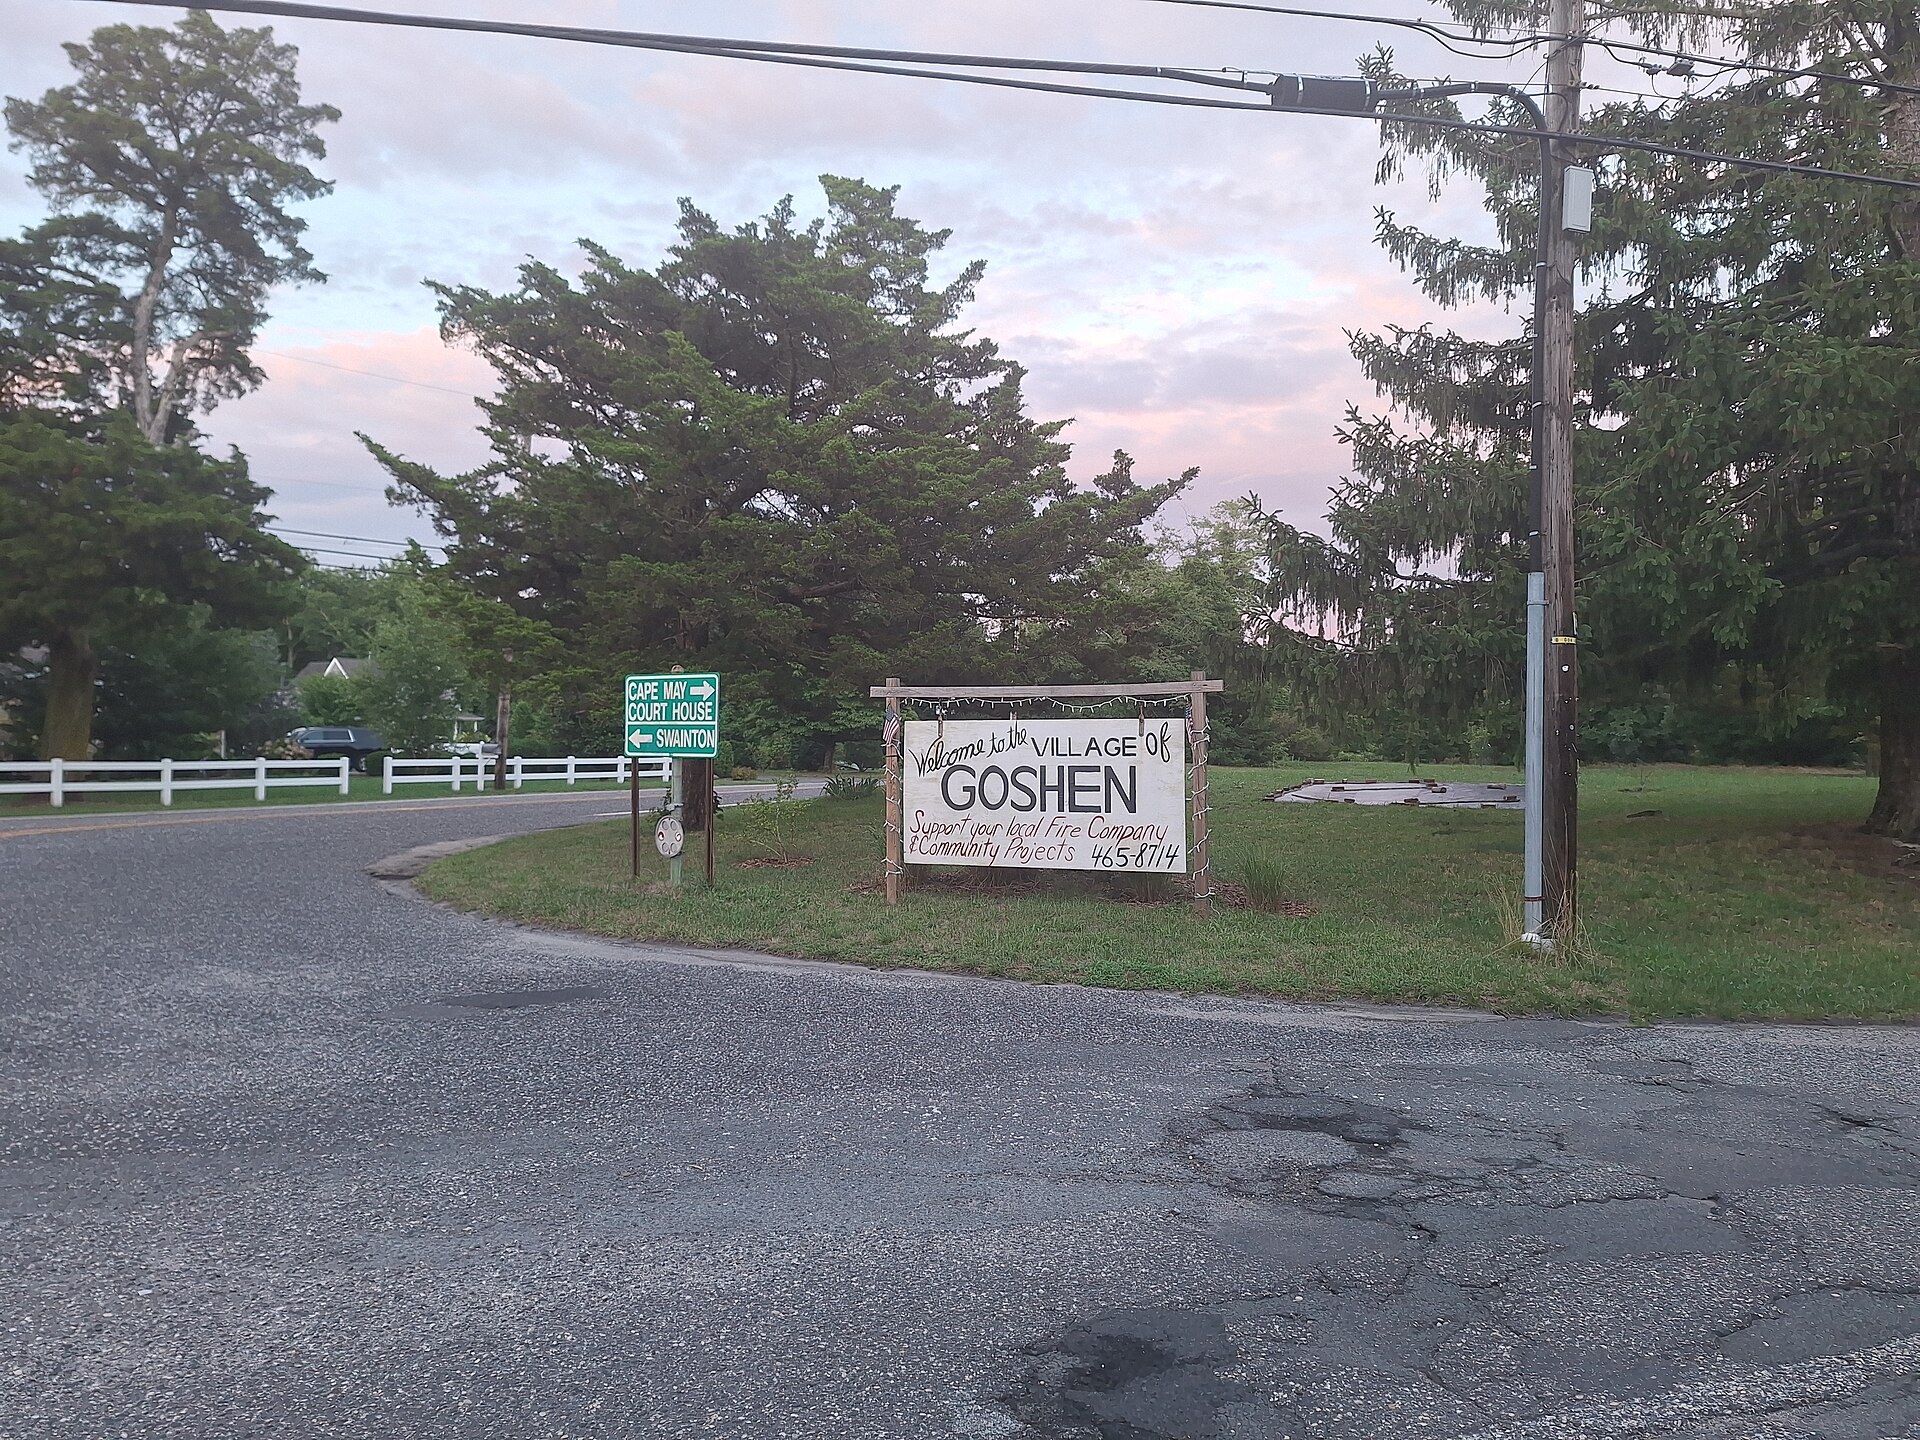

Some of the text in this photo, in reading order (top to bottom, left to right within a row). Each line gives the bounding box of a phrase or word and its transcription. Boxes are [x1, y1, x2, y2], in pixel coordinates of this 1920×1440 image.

[628, 681, 687, 701] CAPE MAY
[628, 701, 713, 721] COURT HOUSE
[656, 728, 715, 749] SWAINTON
[908, 736, 986, 777] Welcome
[987, 732, 1006, 757] to
[1005, 721, 1028, 751] the
[1031, 737, 1137, 757] VILLAGE
[940, 764, 1137, 814] GOSHEN
[909, 810, 1169, 848] Support your local Fire Company
[1004, 836, 1076, 864] Projects
[1091, 842, 1180, 869] 465-8714
